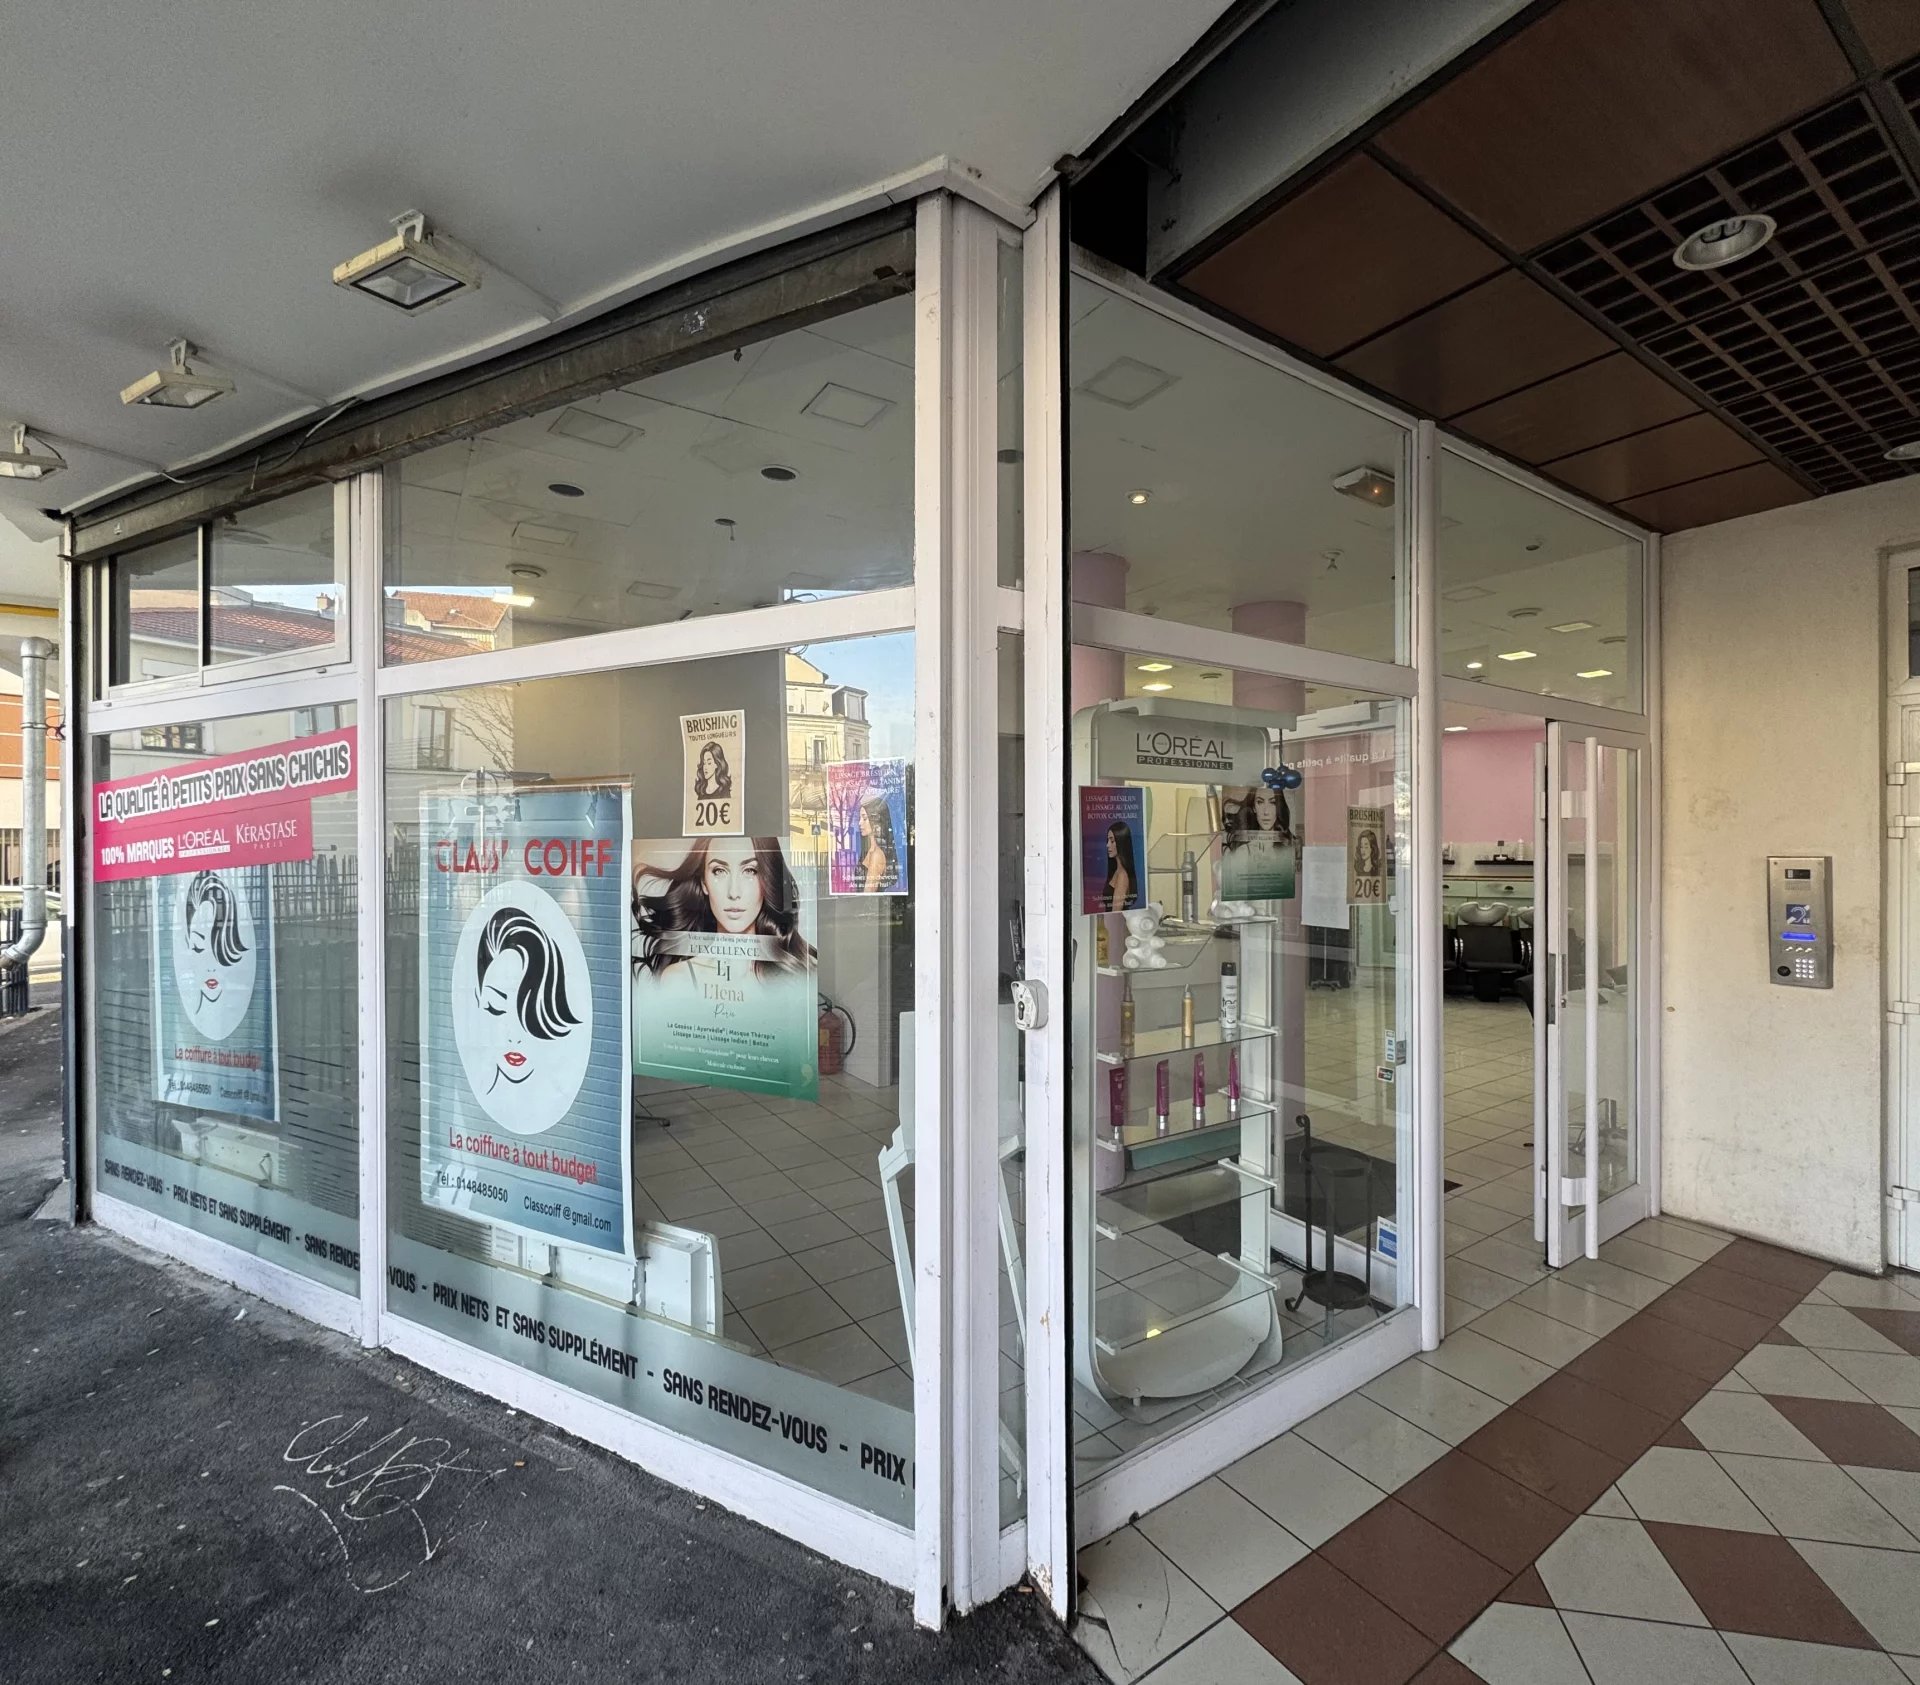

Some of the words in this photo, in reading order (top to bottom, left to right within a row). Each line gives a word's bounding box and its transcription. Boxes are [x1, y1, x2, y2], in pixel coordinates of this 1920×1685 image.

[686, 715, 738, 733] BRUSHING
[688, 734, 706, 742] TOUTES
[1136, 731, 1234, 760] L'ORÉAL
[1137, 756, 1233, 770] PROFESSIONNEL
[99, 792, 114, 820] LA
[115, 780, 159, 821] QUALITÉ
[160, 777, 171, 809] À
[172, 772, 213, 807] PETITS
[214, 765, 246, 799] PRIX
[247, 756, 286, 793] SANS
[287, 742, 350, 786] CHICHIS
[695, 801, 731, 827] 20€
[178, 828, 230, 850] L'ORÉAL
[236, 819, 298, 845] KÉRASTASE
[102, 846, 125, 866] 100%
[126, 837, 175, 863] MARQUES
[253, 841, 284, 851] PARIS
[524, 838, 613, 877] COIFF
[1354, 878, 1381, 899] 20€
[449, 1126, 463, 1148] La
[466, 1131, 510, 1160] coiffure
[513, 1142, 519, 1164] à
[522, 1146, 549, 1170] tout
[552, 1151, 599, 1185] budget
[435, 1170, 449, 1186] Tél
[456, 1176, 509, 1204] 0148485050
[523, 1196, 562, 1219] Classcoiff
[104, 1158, 120, 1178] SANS
[121, 1164, 164, 1195] RENDEZ-VOUS
[173, 1184, 189, 1206] PRIX
[190, 1189, 208, 1212] NETS
[208, 1197, 218, 1216] ET
[218, 1201, 238, 1224] SANS
[239, 1208, 292, 1245] SUPPLÉMENT
[304, 1233, 328, 1259] SANS
[329, 1242, 360, 1272] RENDE
[433, 1281, 459, 1311] PRIX
[461, 1292, 490, 1323] NETS
[496, 1305, 510, 1330] ET
[512, 1311, 546, 1344] SANS
[548, 1324, 639, 1380] SUPPLÉMENT
[663, 1367, 704, 1406] SANS
[708, 1384, 828, 1455] RENDEZ-VOUS
[860, 1442, 907, 1487] PRIX
